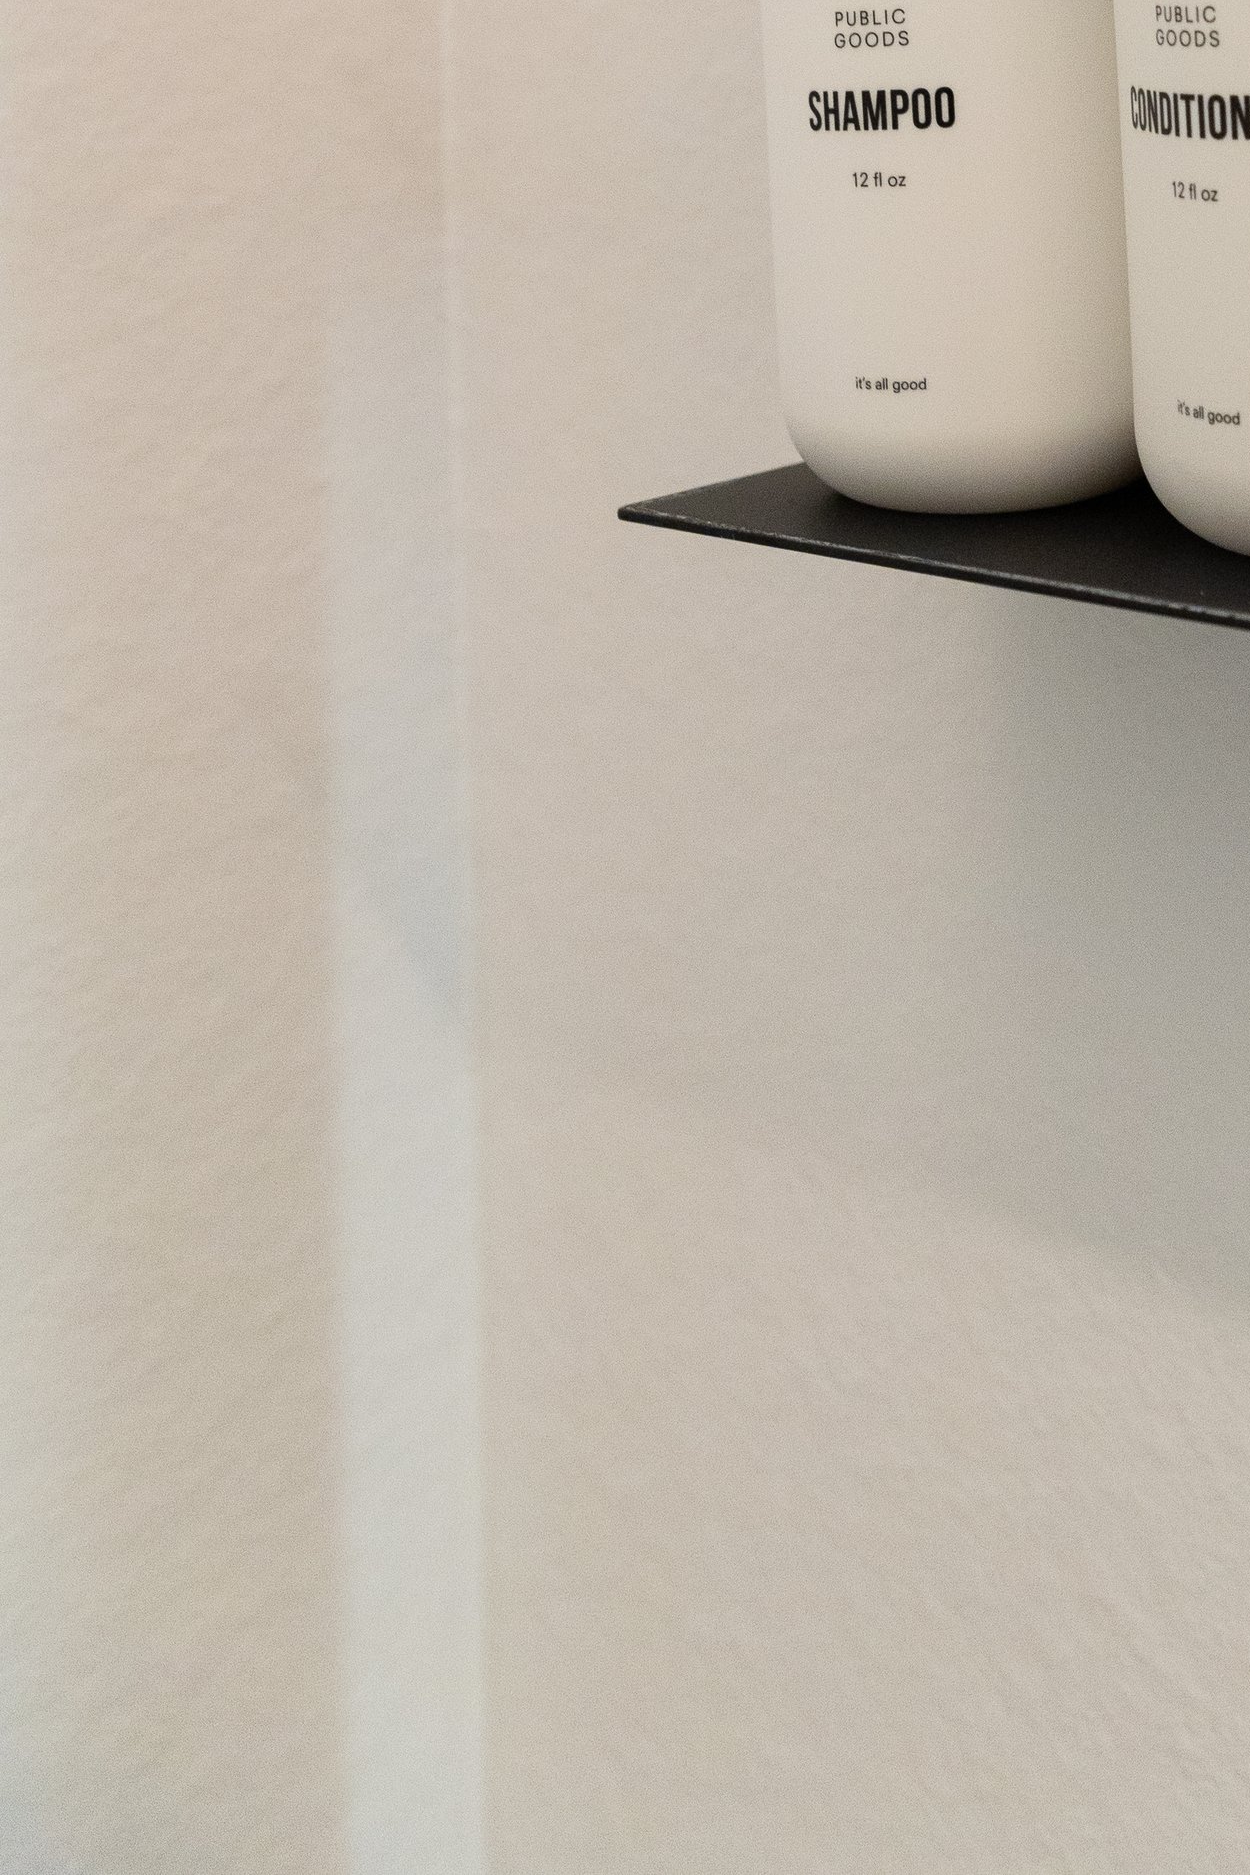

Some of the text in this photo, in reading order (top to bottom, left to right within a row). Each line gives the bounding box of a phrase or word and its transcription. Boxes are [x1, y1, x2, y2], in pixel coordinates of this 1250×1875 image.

[834, 7, 907, 28] PUBLIC
[1155, 4, 1217, 24] PUBLIC
[833, 29, 910, 50] GOODS
[1155, 28, 1221, 48] GOODS
[807, 85, 957, 133] SHAMPOO
[852, 171, 907, 188] 12 fl oz
[1171, 180, 1219, 203] 12 fl oz
[855, 375, 928, 394] it's all good
[1193, 405, 1205, 420] all
[1207, 411, 1241, 426] good
